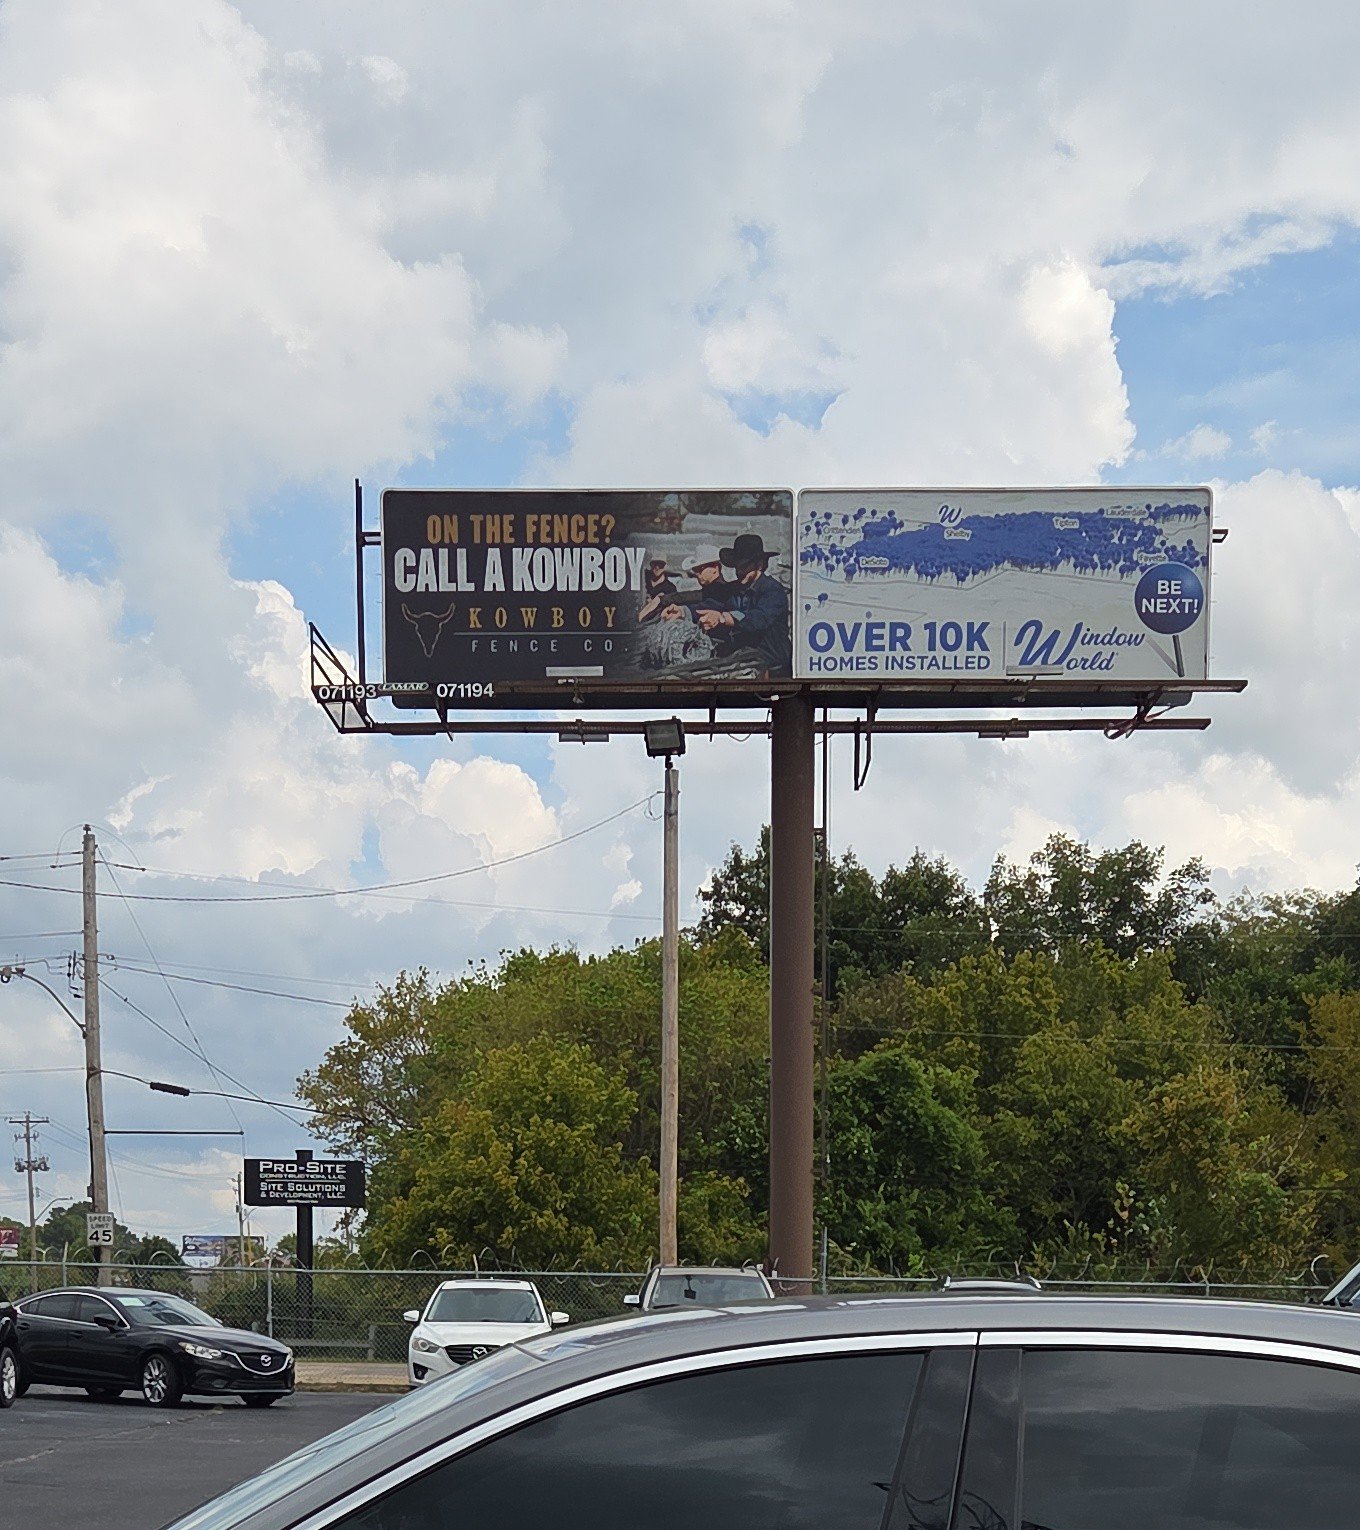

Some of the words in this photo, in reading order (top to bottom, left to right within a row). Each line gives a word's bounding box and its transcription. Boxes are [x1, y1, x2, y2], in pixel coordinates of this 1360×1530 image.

[427, 514, 459, 544] ON
[470, 514, 515, 544] THE
[526, 514, 616, 544] FENCE?
[945, 529, 971, 539] Shelby
[394, 547, 475, 592] CALL
[484, 547, 505, 592] A
[512, 547, 646, 592] KOWBOY
[1157, 580, 1182, 595] BE
[1142, 598, 1198, 614] NEXT!
[469, 607, 616, 628] KOWBOY
[808, 621, 913, 652] OVER
[924, 621, 991, 652] 10K
[1014, 619, 1146, 666] Window
[472, 639, 558, 652] FENCE
[584, 639, 629, 652] CO.
[809, 656, 879, 671] HOMES
[885, 655, 991, 671] INSTALLED
[318, 685, 377, 700] 071193
[436, 683, 495, 698] 071194
[88, 1215, 112, 1223] SPEED
[90, 1222, 110, 1230] LIMIT
[88, 1229, 112, 1243] 45
